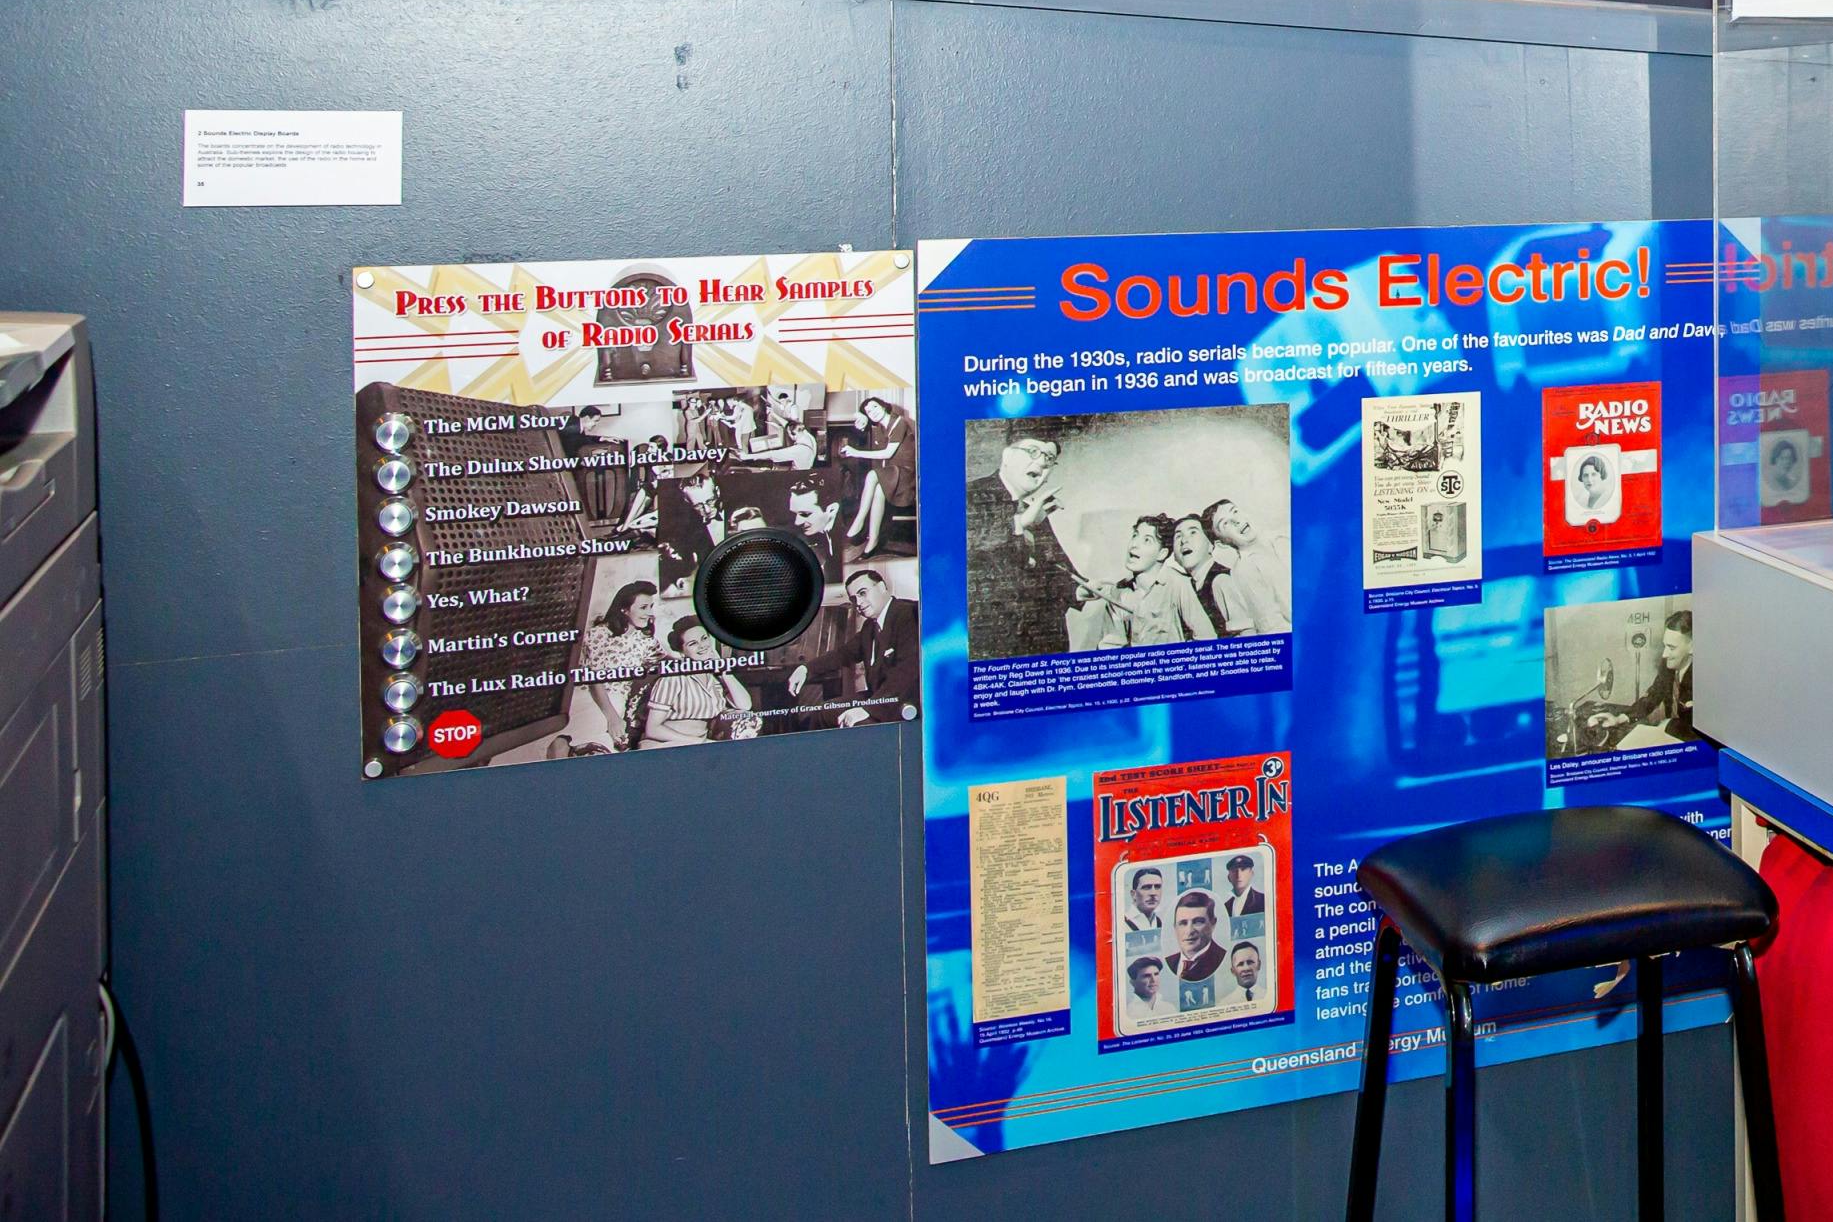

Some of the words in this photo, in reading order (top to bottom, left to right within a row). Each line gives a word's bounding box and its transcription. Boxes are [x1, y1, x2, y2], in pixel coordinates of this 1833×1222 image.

[395, 290, 467, 316] PRESS
[478, 293, 525, 312] THE
[535, 286, 647, 310] BUTTONS
[658, 287, 688, 305] TO
[699, 279, 764, 303] HEAR
[776, 276, 873, 300] SAMPLES
[1059, 258, 1350, 321] Sounds
[1378, 247, 1650, 307] Electric!
[542, 331, 571, 349] OF
[582, 323, 657, 347] RADIO
[667, 318, 753, 343] SERIALS
[964, 352, 1028, 375] During
[1034, 351, 1064, 369] the
[1070, 350, 1130, 369] 1930s,
[1136, 346, 1183, 364] radio
[1188, 345, 1246, 362] serials
[1252, 342, 1322, 360] became
[1327, 338, 1396, 358] popular.
[1401, 336, 1437, 352] One
[1441, 333, 1459, 350] of
[1463, 333, 1489, 349] the
[1493, 329, 1573, 347] favourites
[1577, 330, 1609, 343] was
[1613, 324, 1646, 342] Dad
[1649, 324, 1679, 339] and
[964, 377, 1021, 397] which
[1026, 375, 1086, 396] began
[1091, 374, 1108, 390] in
[1115, 372, 1158, 389] 1936
[1164, 370, 1198, 387] and
[1203, 372, 1239, 385] was
[1244, 364, 1333, 383] broadcast
[1337, 362, 1362, 378] for
[1366, 359, 1418, 377] fifteen
[1422, 359, 1473, 377] years.
[424, 419, 461, 434] The
[466, 415, 515, 432] MGM
[519, 414, 570, 430] Story
[1576, 400, 1648, 429] RADIO
[1595, 417, 1651, 435] NEWS
[424, 462, 463, 477] The
[467, 458, 524, 475] Dulux
[528, 455, 579, 471] Show
[583, 451, 626, 468] with
[630, 449, 672, 468] Jack
[672, 447, 728, 464] Davey
[425, 505, 502, 522] Smokey
[507, 500, 581, 517] Dawson
[426, 551, 463, 566] The
[469, 542, 576, 563] Bunkhouse
[581, 538, 631, 555] Show
[427, 592, 464, 609] Yes,
[470, 586, 530, 606] What?
[1627, 612, 1650, 624] 4BH
[428, 633, 508, 654] Martin's
[513, 629, 579, 647] Corner
[988, 664, 1010, 672] Fourth
[1050, 658, 1076, 667] Percy's
[1093, 654, 1118, 662] another
[1120, 651, 1146, 660] popular
[1148, 649, 1165, 657] radio
[1167, 647, 1193, 656] comedy
[1194, 645, 1215, 653] serial.
[1243, 640, 1270, 649] episode
[429, 680, 466, 697] The
[471, 676, 505, 693] Lux
[511, 670, 566, 690] Radio
[570, 664, 645, 684] Theatre
[660, 651, 766, 676] Kidnapped!
[720, 712, 753, 721] Material
[755, 708, 788, 718] courtesy
[791, 706, 799, 714] of
[800, 704, 822, 713] Grace
[824, 701, 850, 710] Gibson
[852, 696, 898, 708] Productions
[433, 724, 477, 743] STOP
[1120, 771, 1146, 780] TEST
[1149, 768, 1184, 777] SCORE
[976, 791, 999, 803] 4QG
[1099, 785, 1253, 843] LISTENER
[1255, 776, 1289, 821] IN
[1313, 862, 1344, 878] The
[1314, 904, 1345, 918] The
[1315, 928, 1325, 939] a
[1329, 917, 1376, 940] pencil
[1315, 963, 1345, 980] and
[1315, 984, 1349, 1000] fans
[1316, 1002, 1368, 1021] leaving
[1251, 1042, 1357, 1075] Queensland
